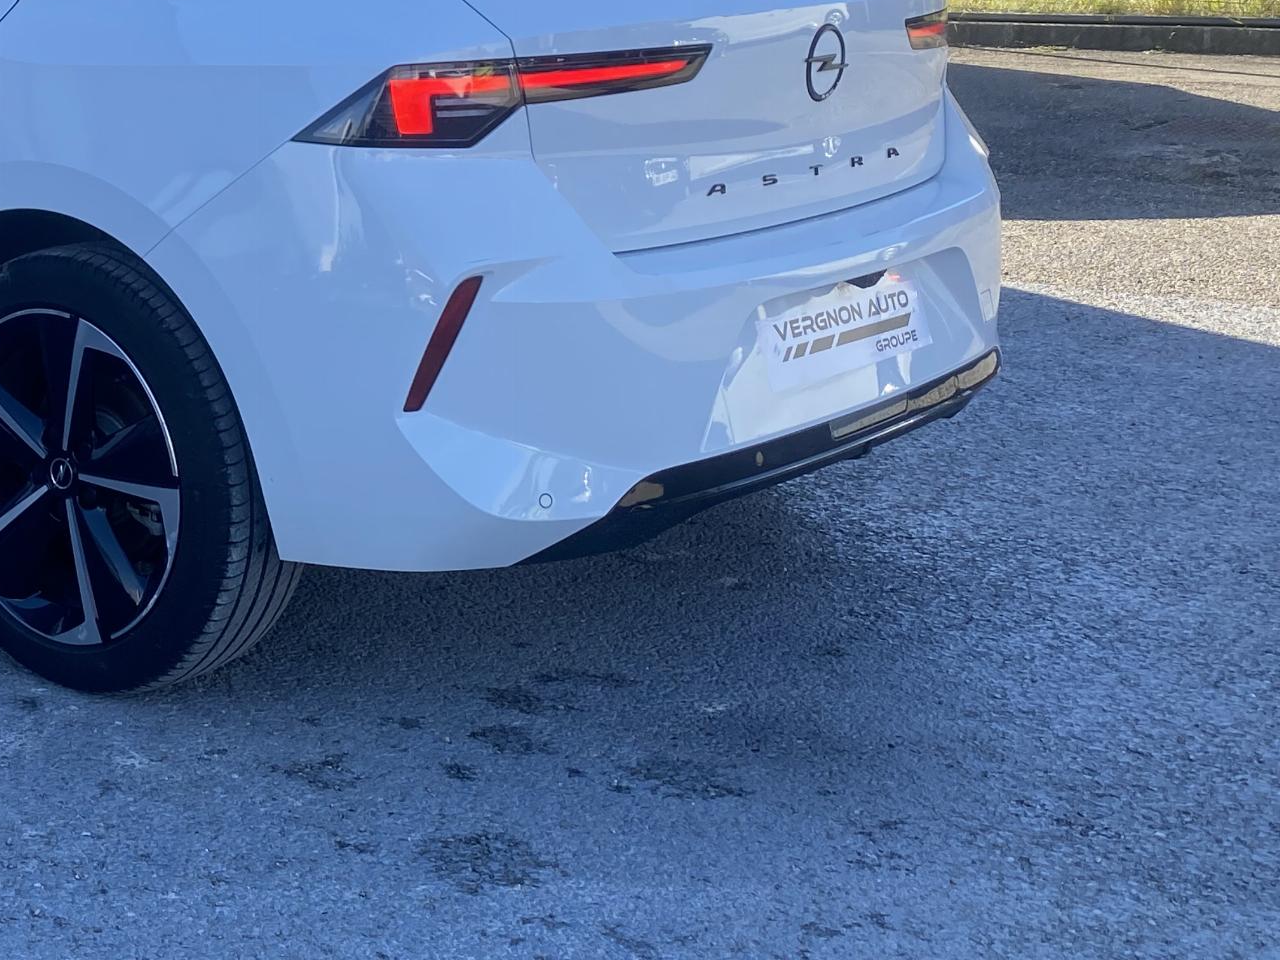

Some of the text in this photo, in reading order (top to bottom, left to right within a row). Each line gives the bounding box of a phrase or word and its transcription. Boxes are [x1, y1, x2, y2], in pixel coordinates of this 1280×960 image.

[707, 146, 900, 197] ASTRA
[773, 289, 910, 341] VERGNON AUTO
[875, 329, 918, 352] GROUPE
